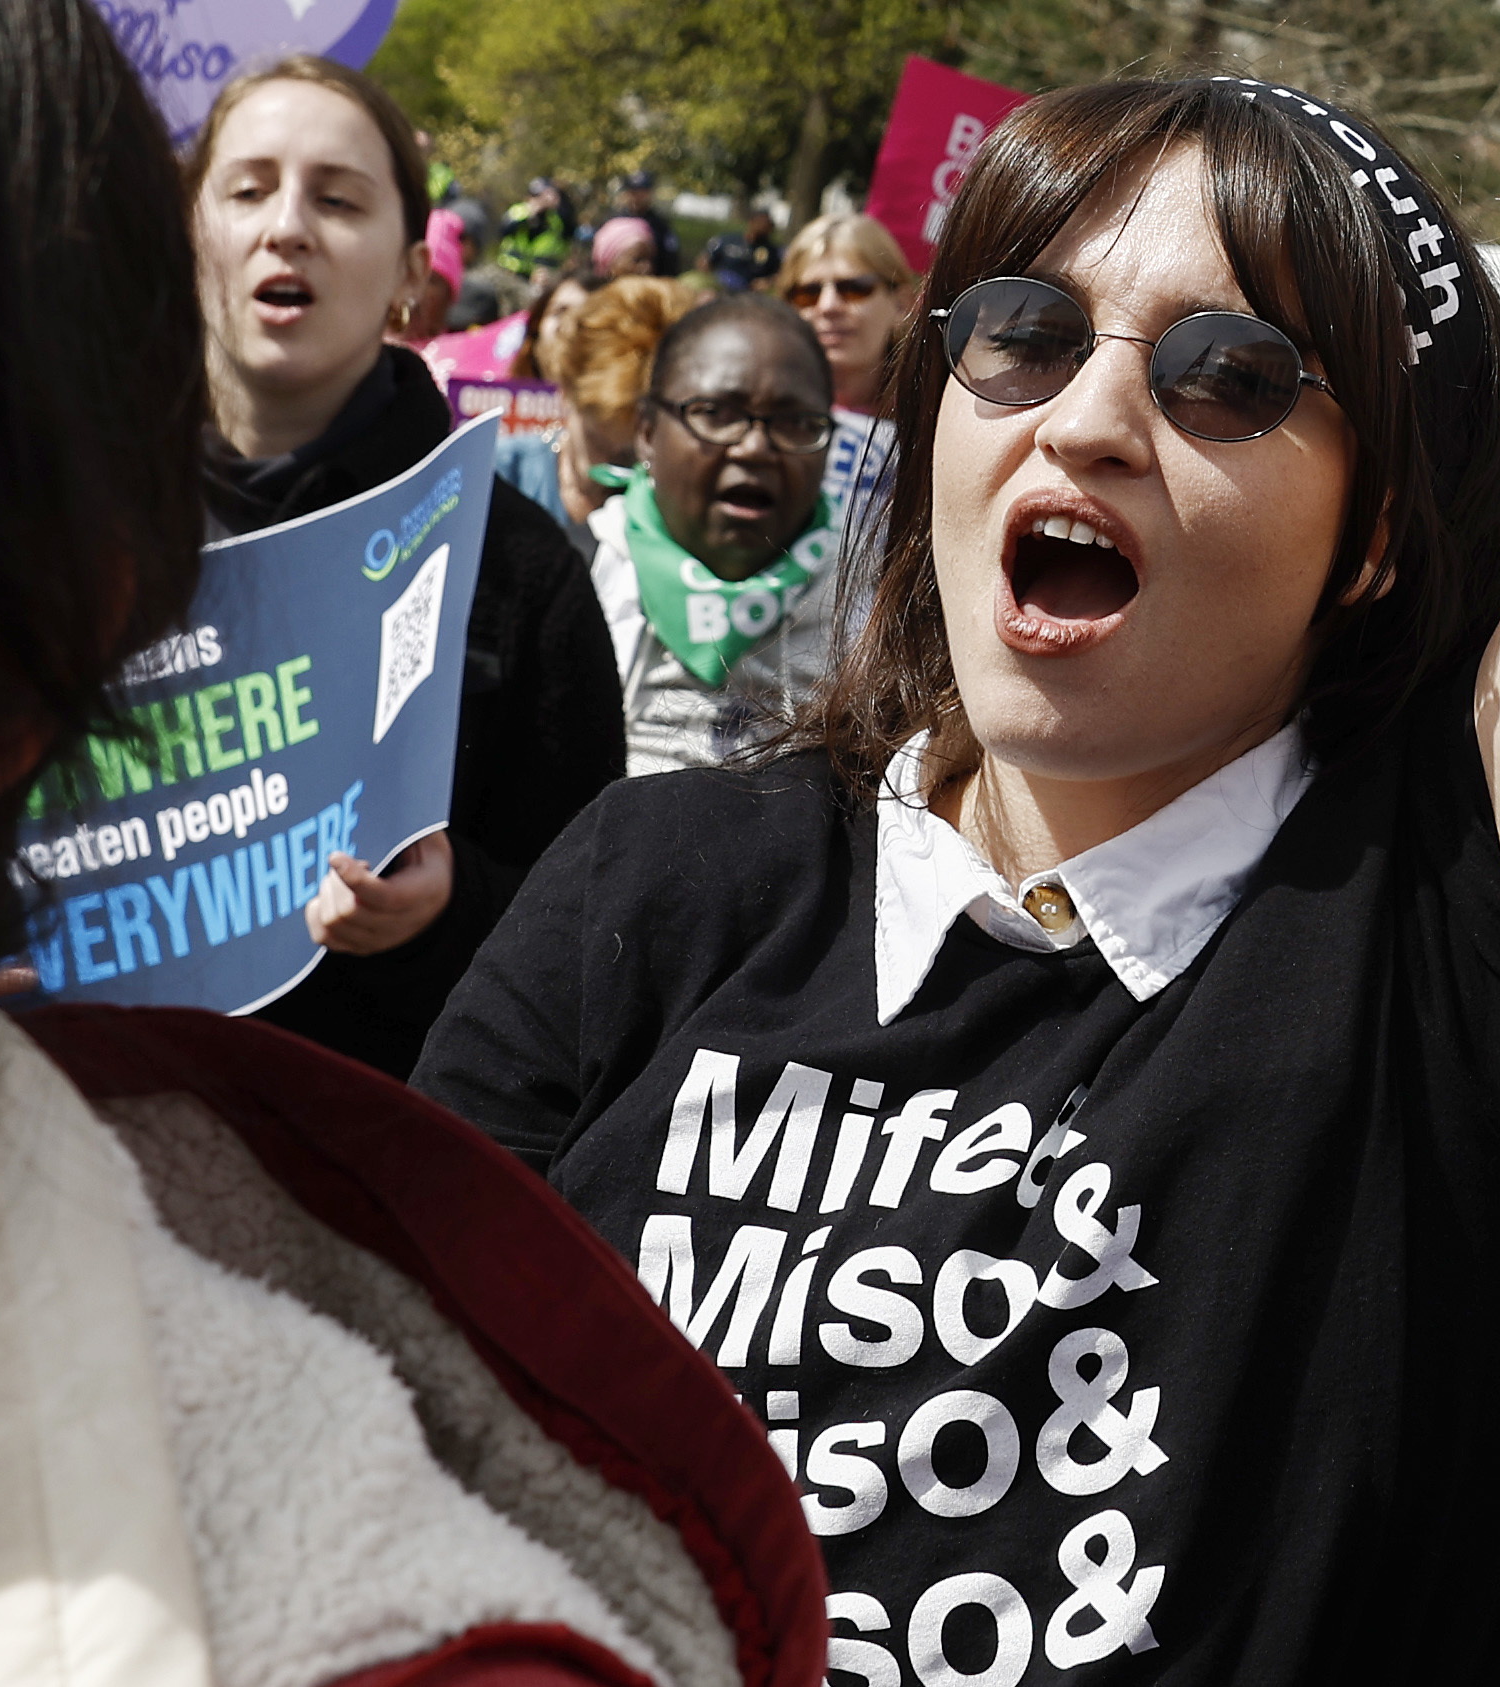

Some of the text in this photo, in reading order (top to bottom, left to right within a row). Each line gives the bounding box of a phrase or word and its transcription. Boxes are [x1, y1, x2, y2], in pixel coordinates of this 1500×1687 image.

[24, 778, 365, 995] VERYWHERE
[156, 767, 290, 862] people
[730, 1327, 1171, 1537] iso&
